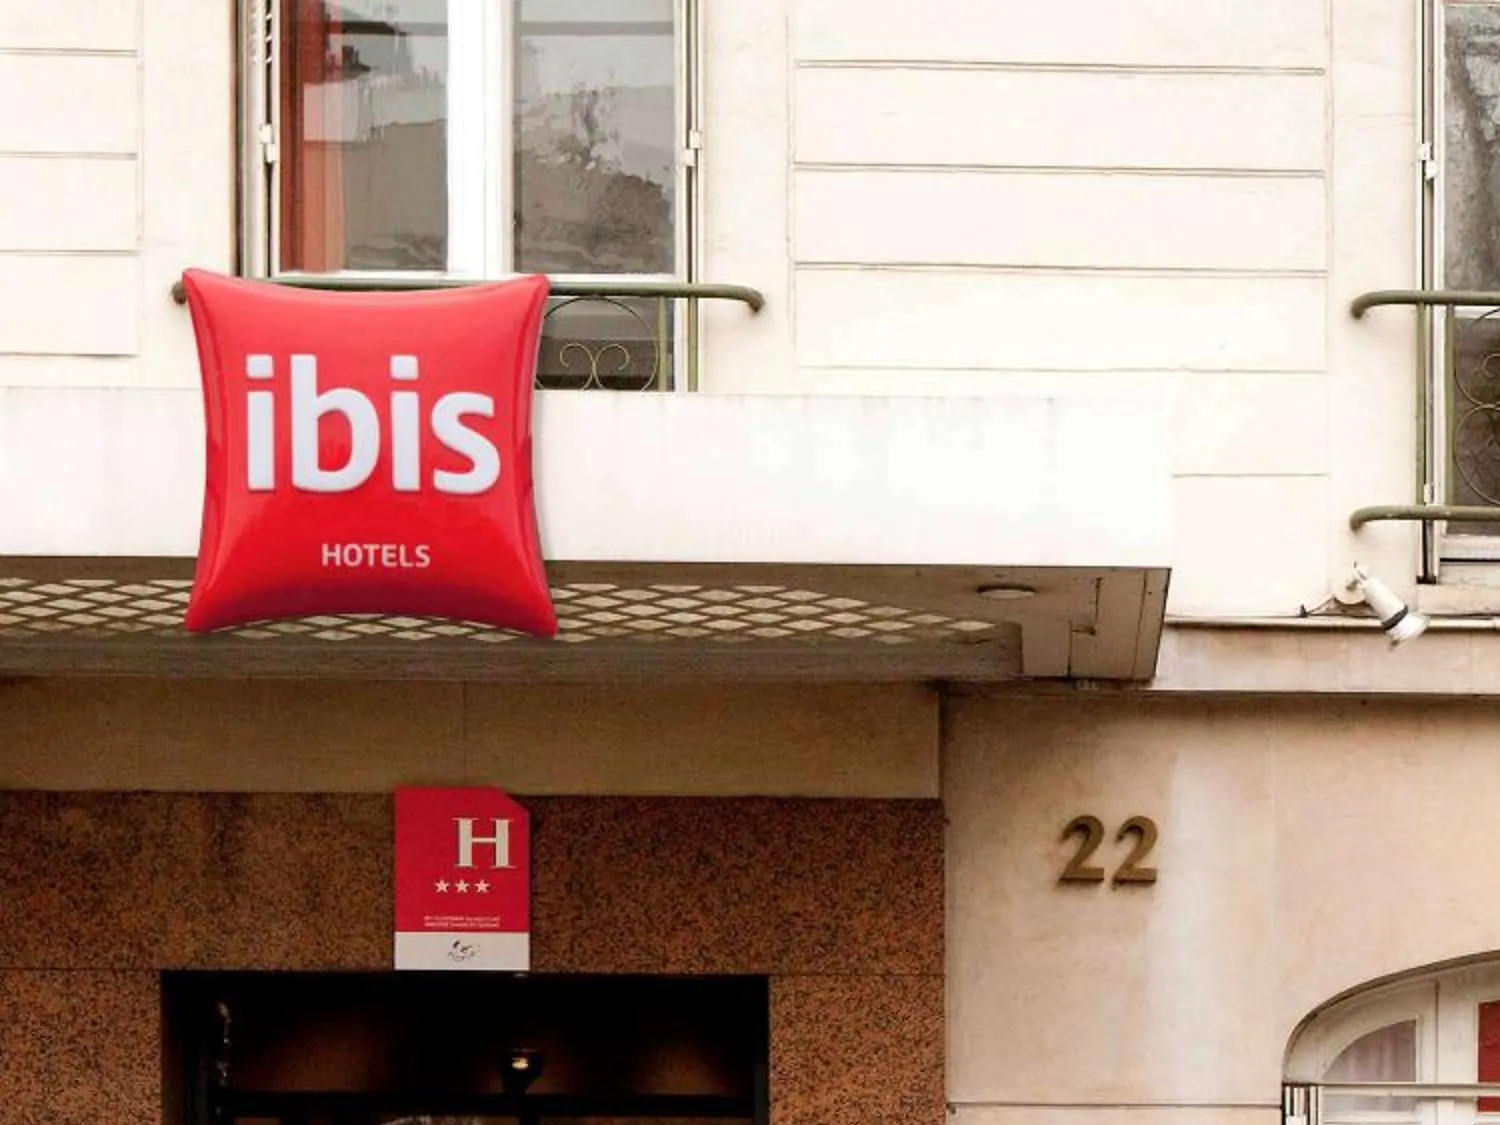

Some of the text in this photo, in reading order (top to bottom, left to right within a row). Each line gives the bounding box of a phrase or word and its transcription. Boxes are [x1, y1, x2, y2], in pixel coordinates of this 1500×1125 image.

[245, 354, 501, 494] ibis
[321, 543, 431, 568] HOTELS
[452, 817, 517, 869] H
[1057, 815, 1158, 888] 22
